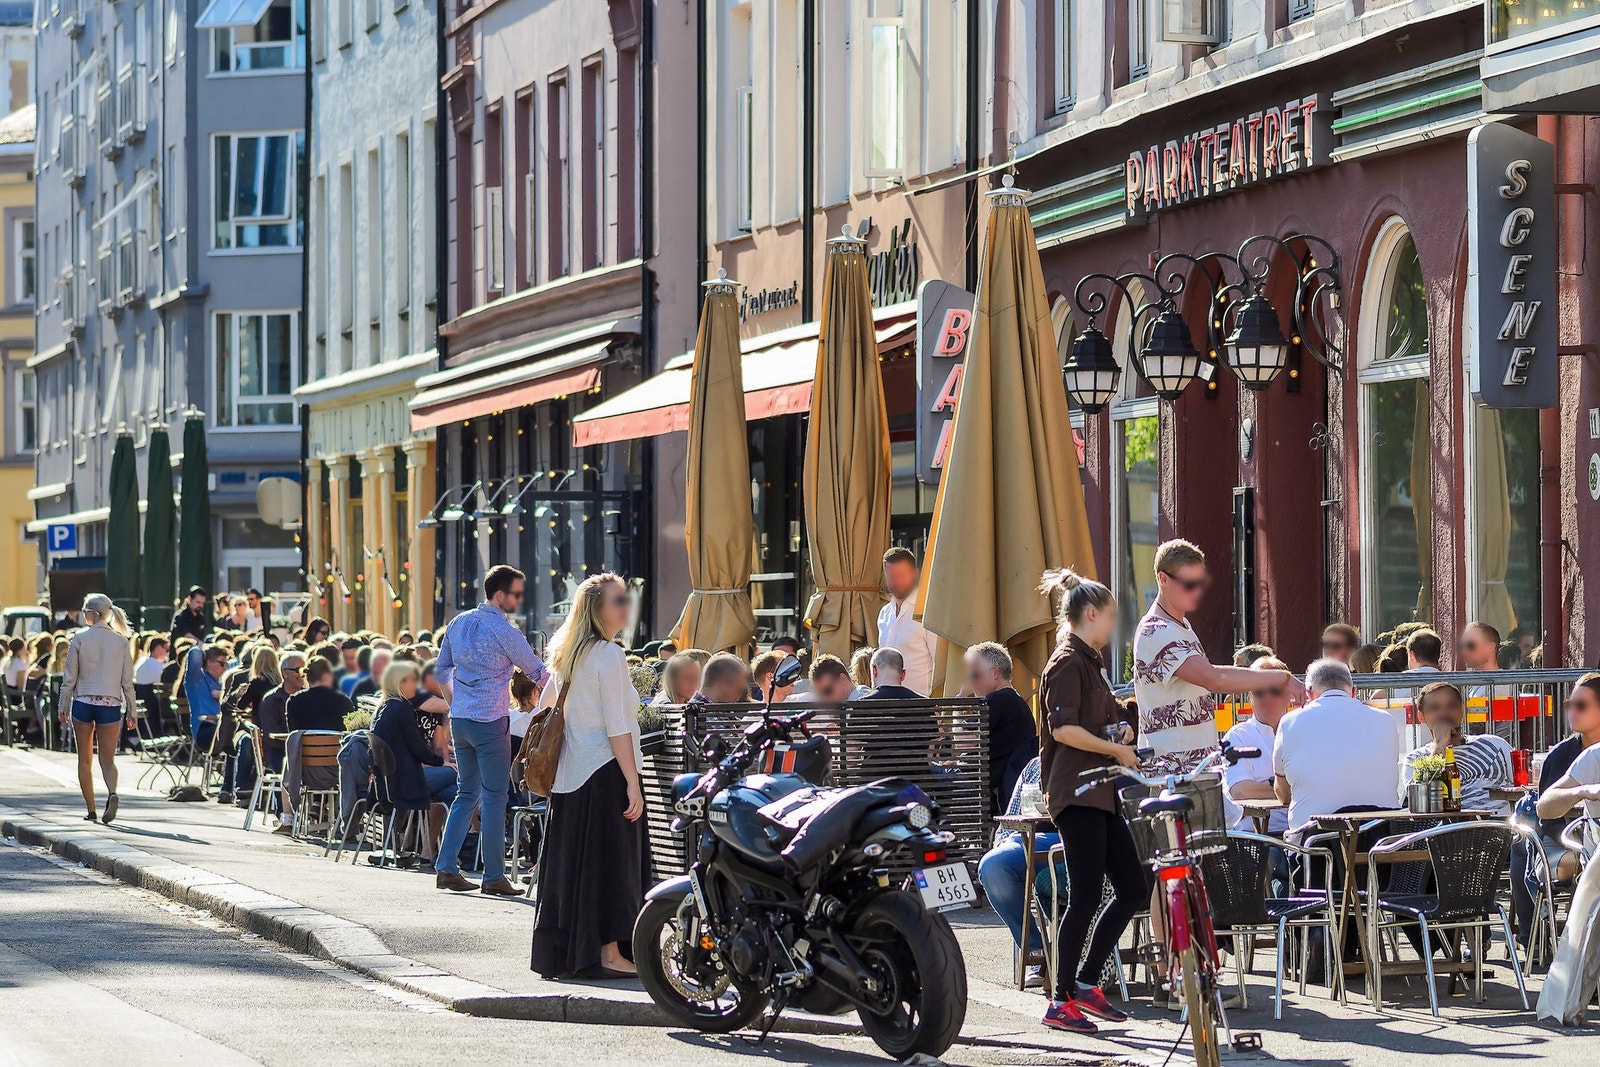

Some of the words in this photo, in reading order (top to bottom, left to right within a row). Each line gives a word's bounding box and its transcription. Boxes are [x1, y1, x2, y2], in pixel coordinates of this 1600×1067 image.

[1126, 93, 1318, 217] PARKTEATRET
[1497, 159, 1541, 386] SCENE
[54, 526, 69, 549] P
[937, 867, 957, 884] BH
[938, 883, 970, 902] 4565
